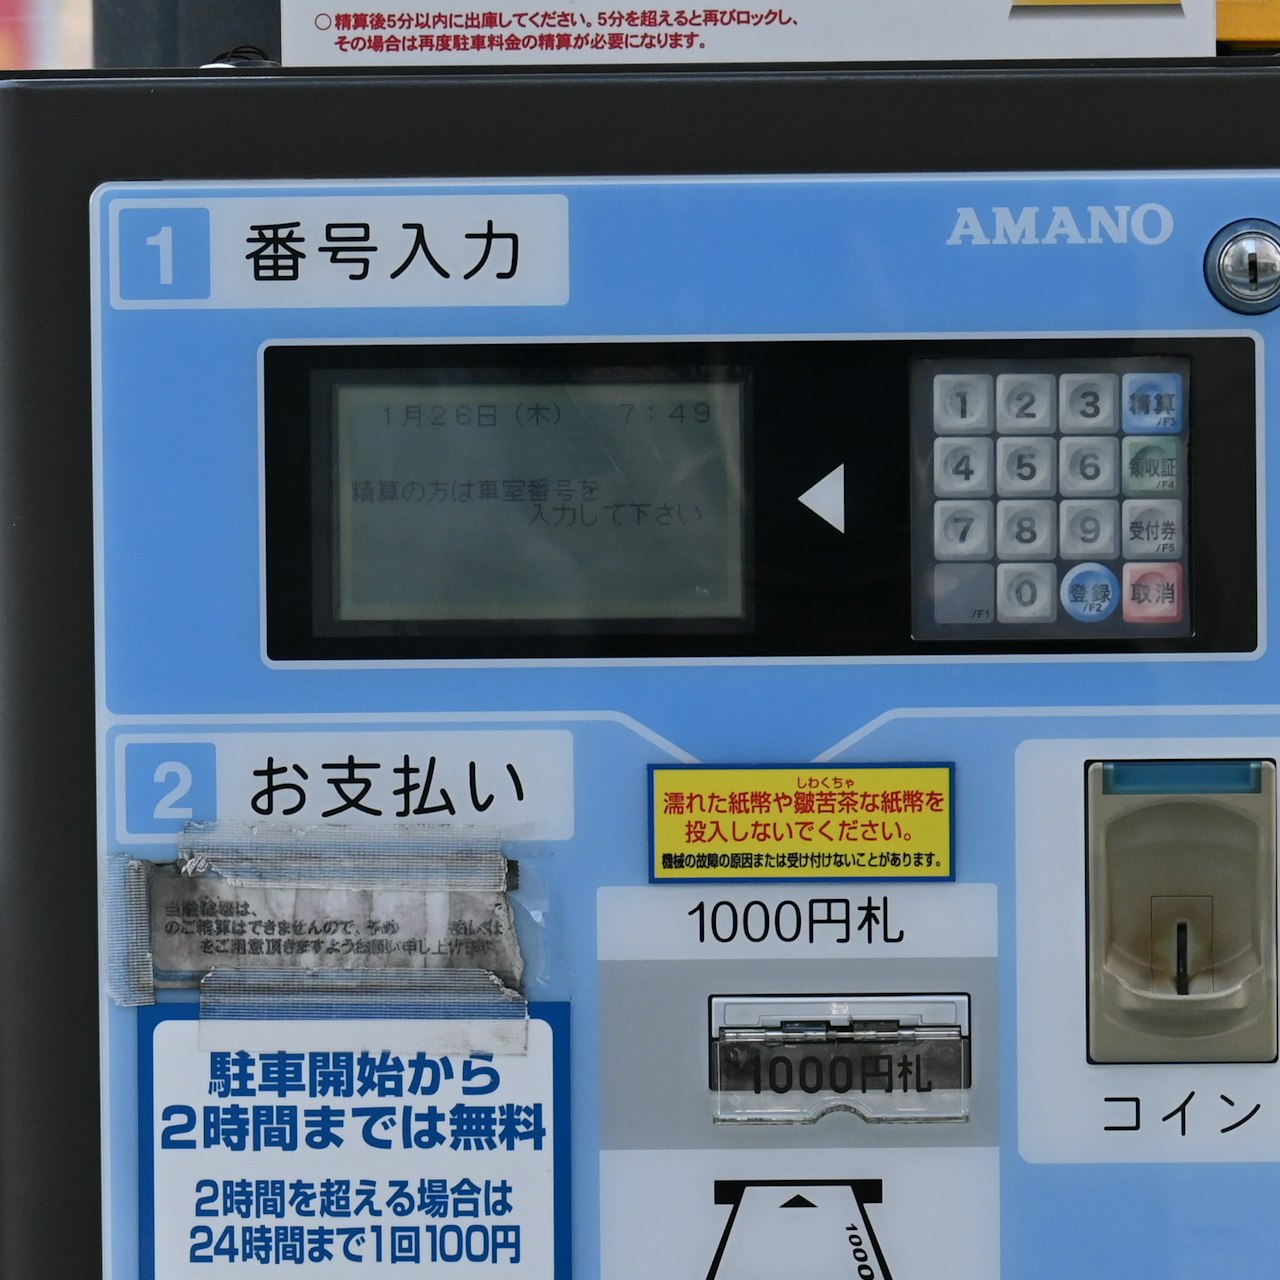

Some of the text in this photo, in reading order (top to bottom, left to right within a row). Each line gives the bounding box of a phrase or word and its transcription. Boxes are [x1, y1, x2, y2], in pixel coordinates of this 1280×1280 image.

[334, 32, 707, 52] その場合は再度駐車料金の精算が必要になります。
[945, 202, 1175, 246] AMANO
[146, 225, 174, 286] 1
[245, 219, 520, 282] 番号入力
[955, 391, 968, 419] 1
[1015, 391, 1037, 419] 2
[1079, 390, 1101, 419] 3
[1129, 391, 1176, 416] 精算
[951, 454, 974, 481] 4
[1015, 453, 1037, 481] 5
[1079, 452, 1101, 481] 6
[1129, 457, 1177, 479] 領収証
[350, 478, 600, 503] 精算の方は車室番号を
[527, 502, 704, 527] 入力して下さい
[953, 516, 975, 544] 7
[1015, 516, 1038, 544] 8
[1079, 515, 1102, 543] 9
[1129, 519, 1177, 542] 受付券
[1014, 579, 1038, 608] 0
[1070, 583, 1112, 604] 登録
[1129, 582, 1175, 605] 取消
[152, 760, 194, 820] 2
[250, 754, 526, 818] お支払い
[796, 776, 855, 789] しわくちゃ
[685, 820, 912, 844] 投入しないでください。
[662, 852, 942, 870] 機械の故障の原因または受け付けないことがあります。
[688, 896, 905, 945] 1000円札
[208, 1049, 502, 1099] 駐車開始から
[750, 1054, 933, 1095] 1000円札
[160, 1102, 548, 1152] 2時間までは無料
[1104, 1090, 1261, 1137] コイン
[194, 1178, 514, 1219] 2時間を超える場合は
[189, 1224, 521, 1266] 24時間まで1回100円
